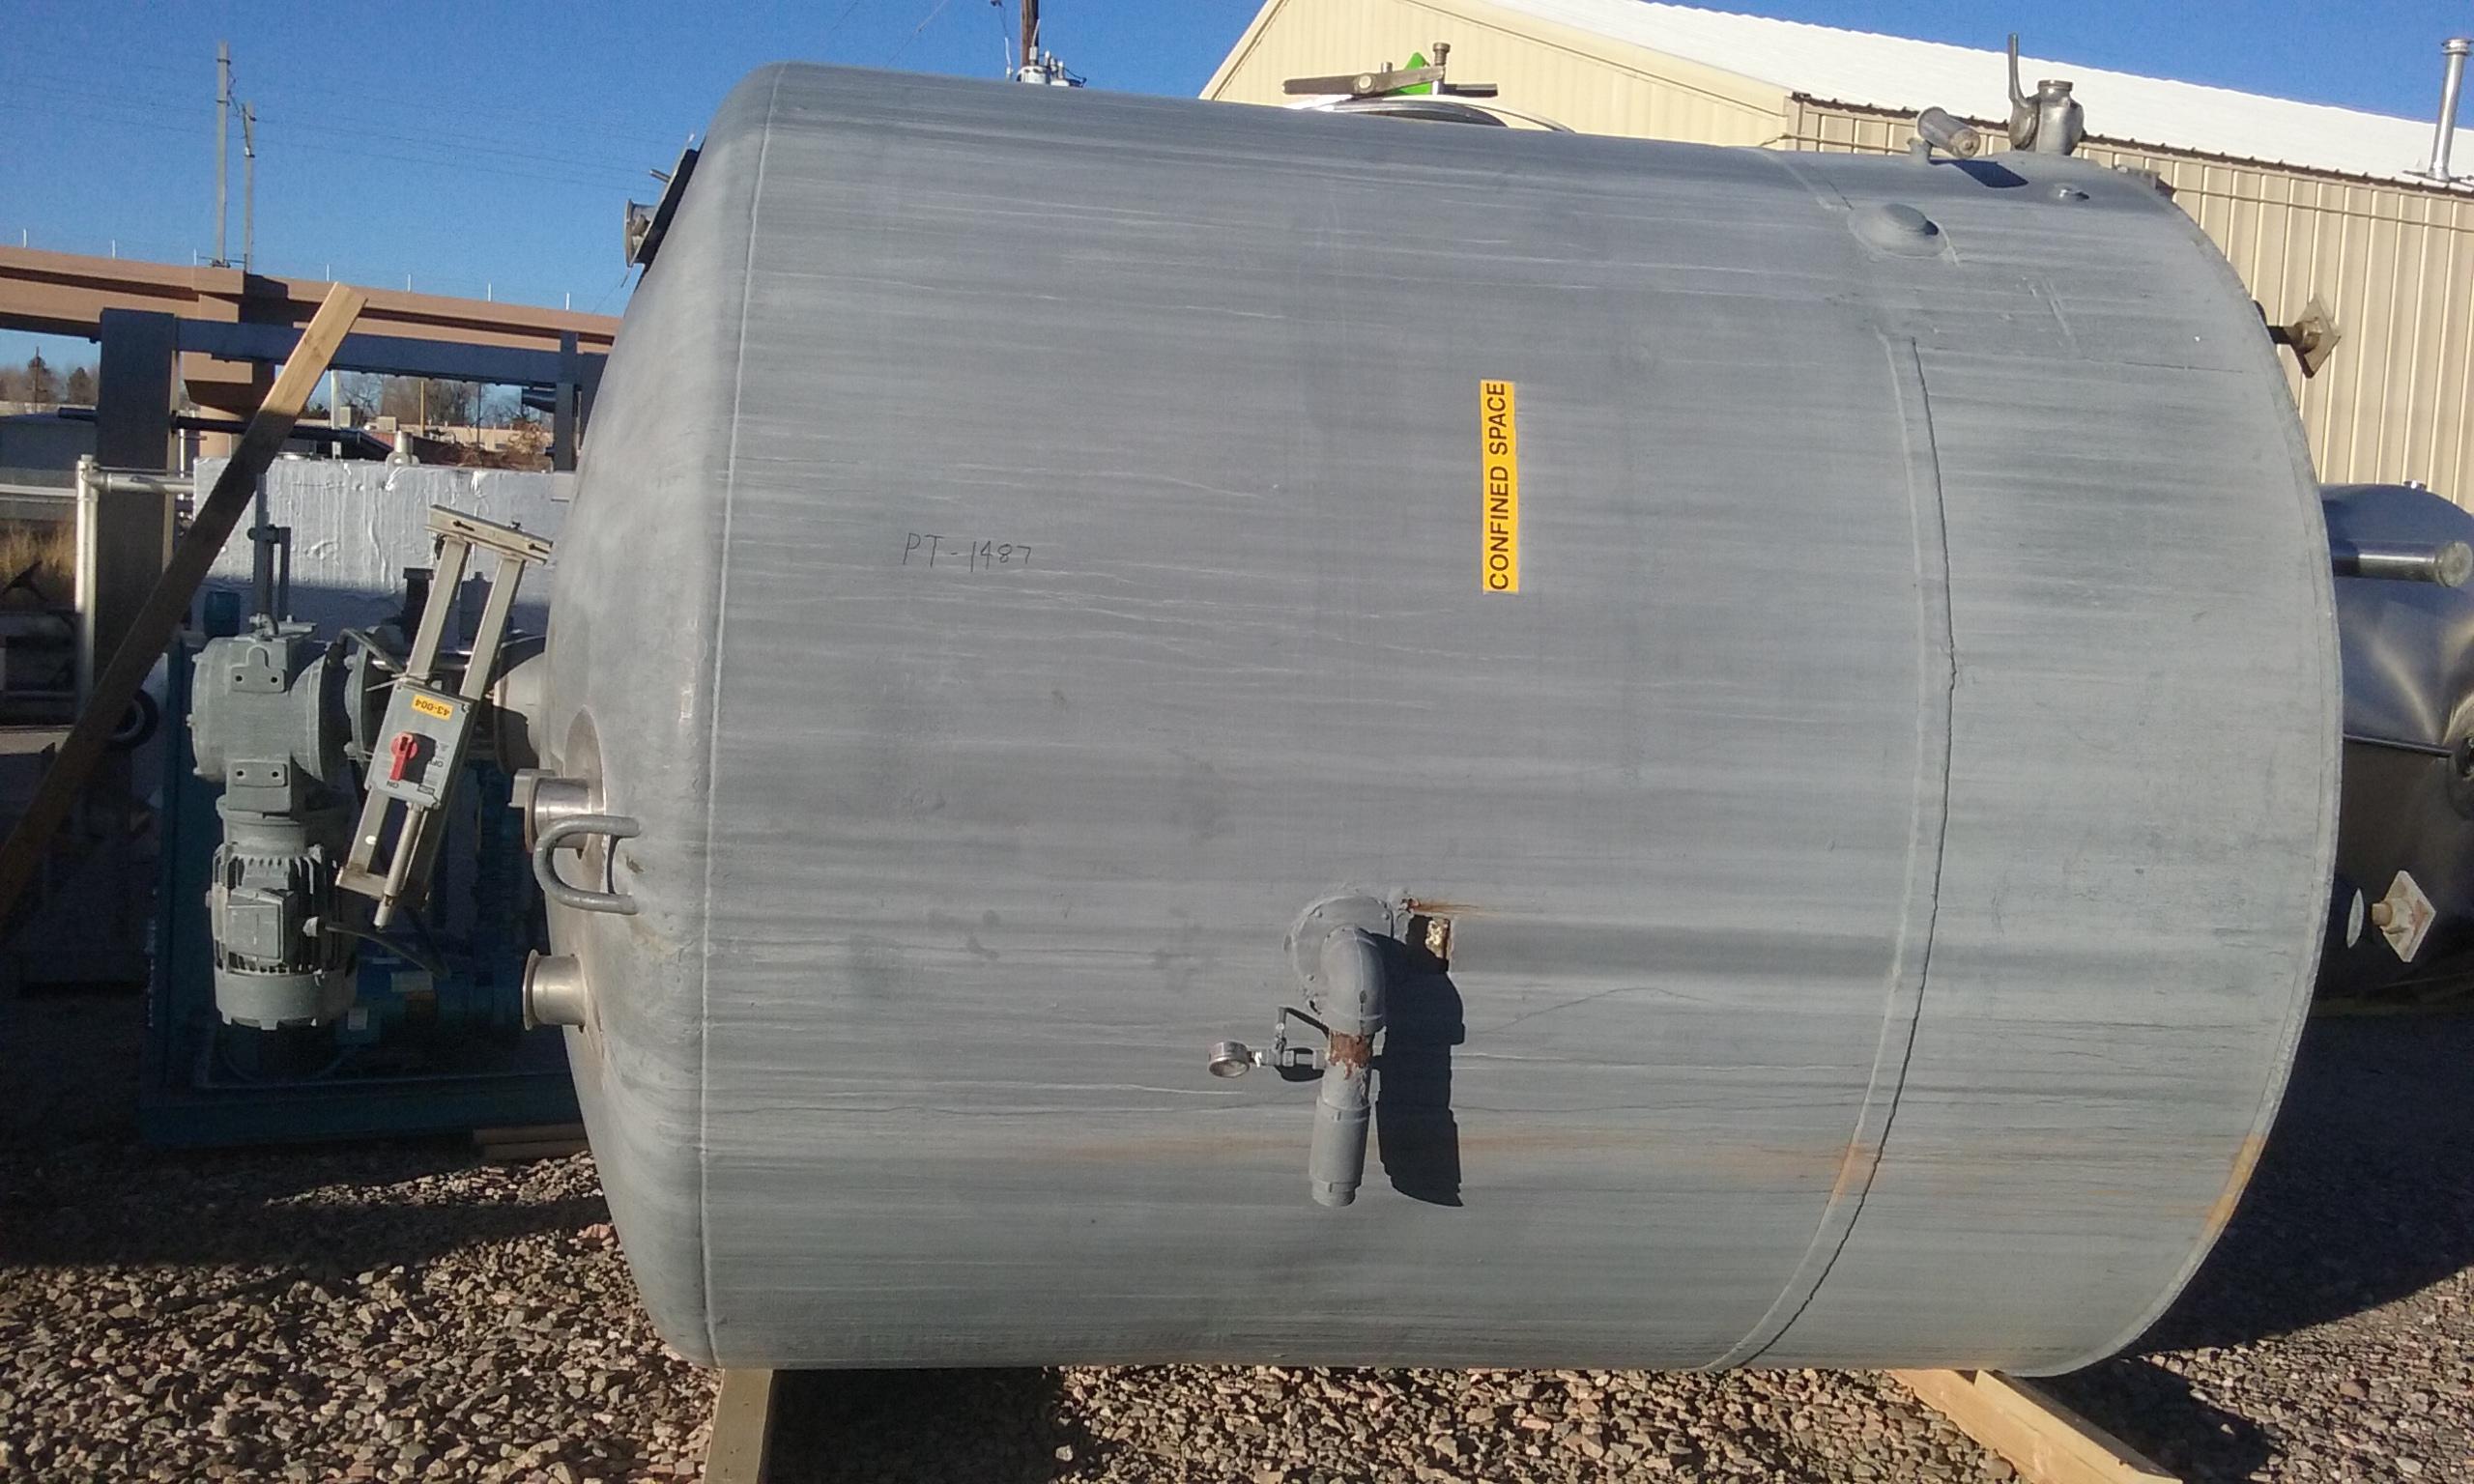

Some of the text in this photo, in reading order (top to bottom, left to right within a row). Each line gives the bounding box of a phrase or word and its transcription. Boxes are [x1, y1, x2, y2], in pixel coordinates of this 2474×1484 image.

[1486, 383, 1510, 590] CONFINED SPACE
[903, 532, 1031, 572] PT-1487
[416, 699, 449, 716] 43-004
